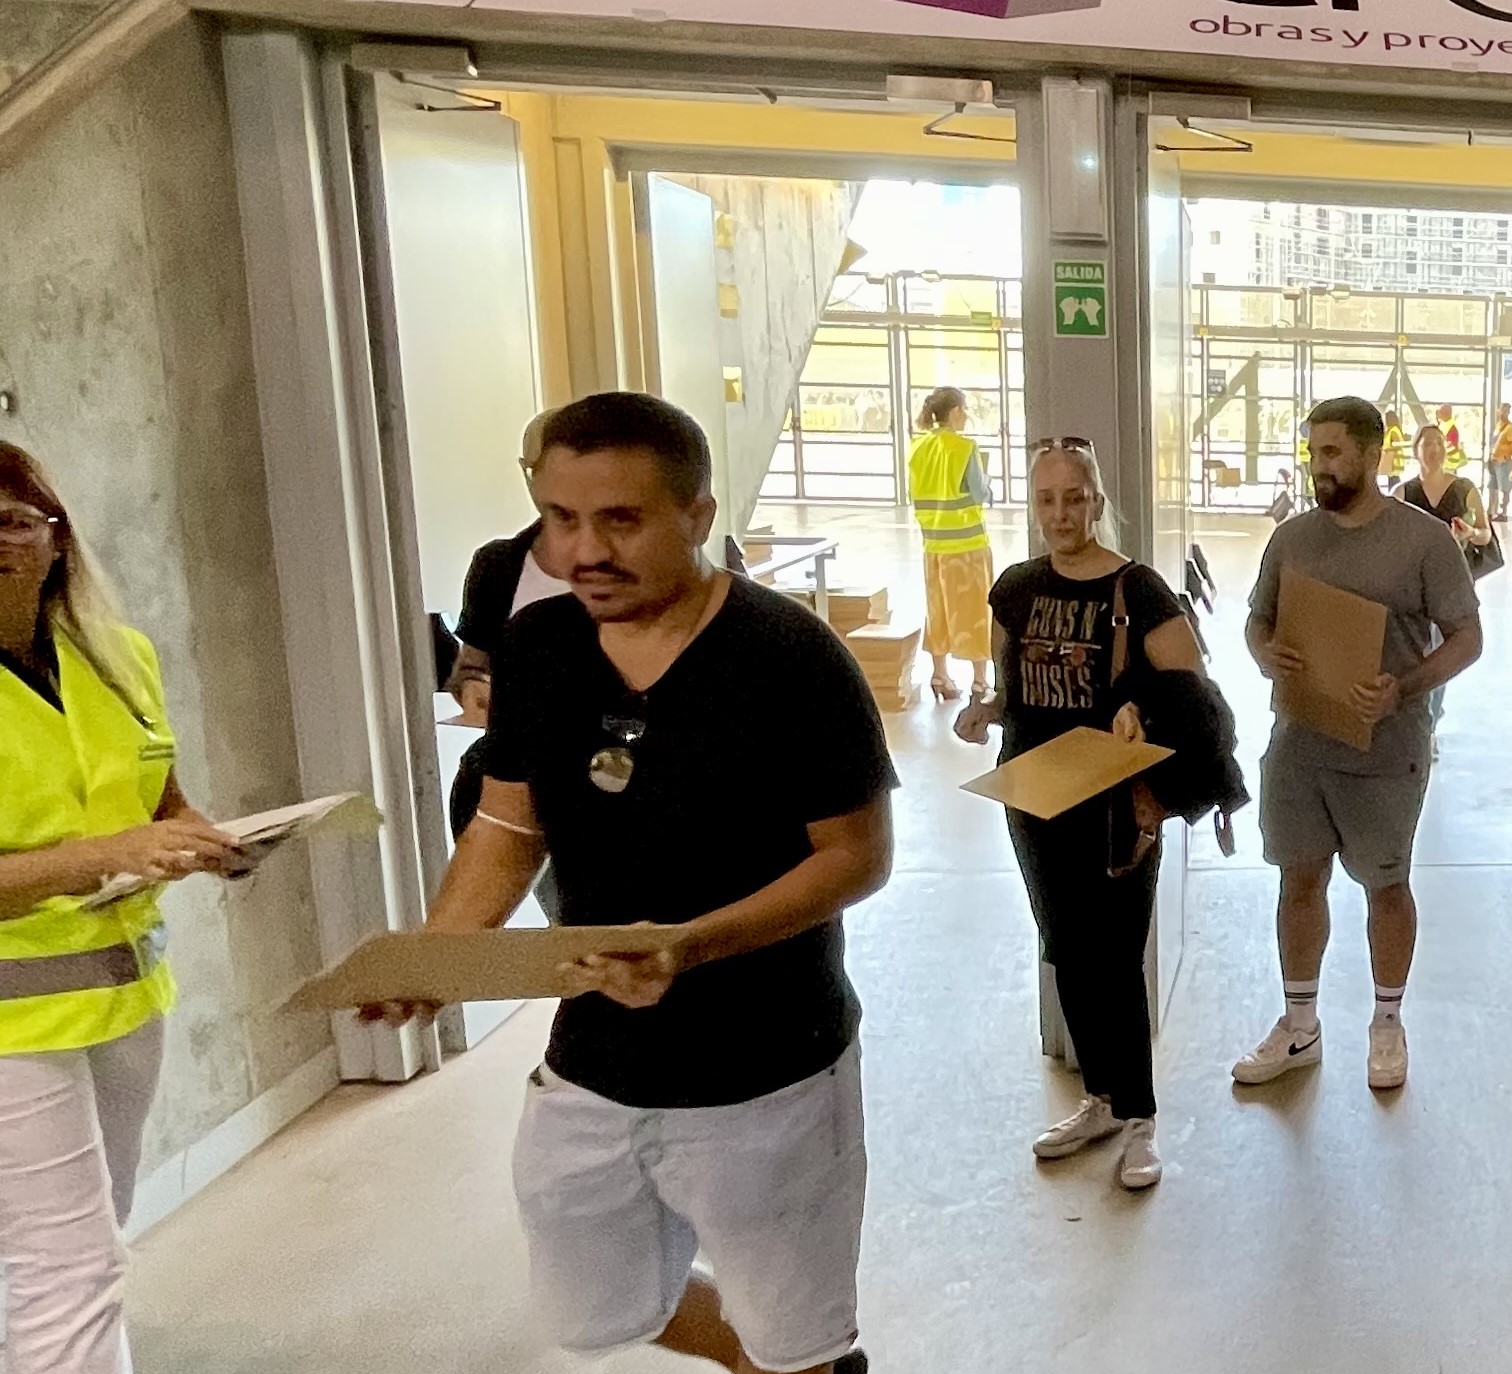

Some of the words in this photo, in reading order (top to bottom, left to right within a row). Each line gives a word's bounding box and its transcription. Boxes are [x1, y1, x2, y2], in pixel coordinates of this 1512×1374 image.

[1188, 14, 1334, 43] obras
[1330, 26, 1370, 48] y
[1056, 265, 1103, 280] SALIDA
